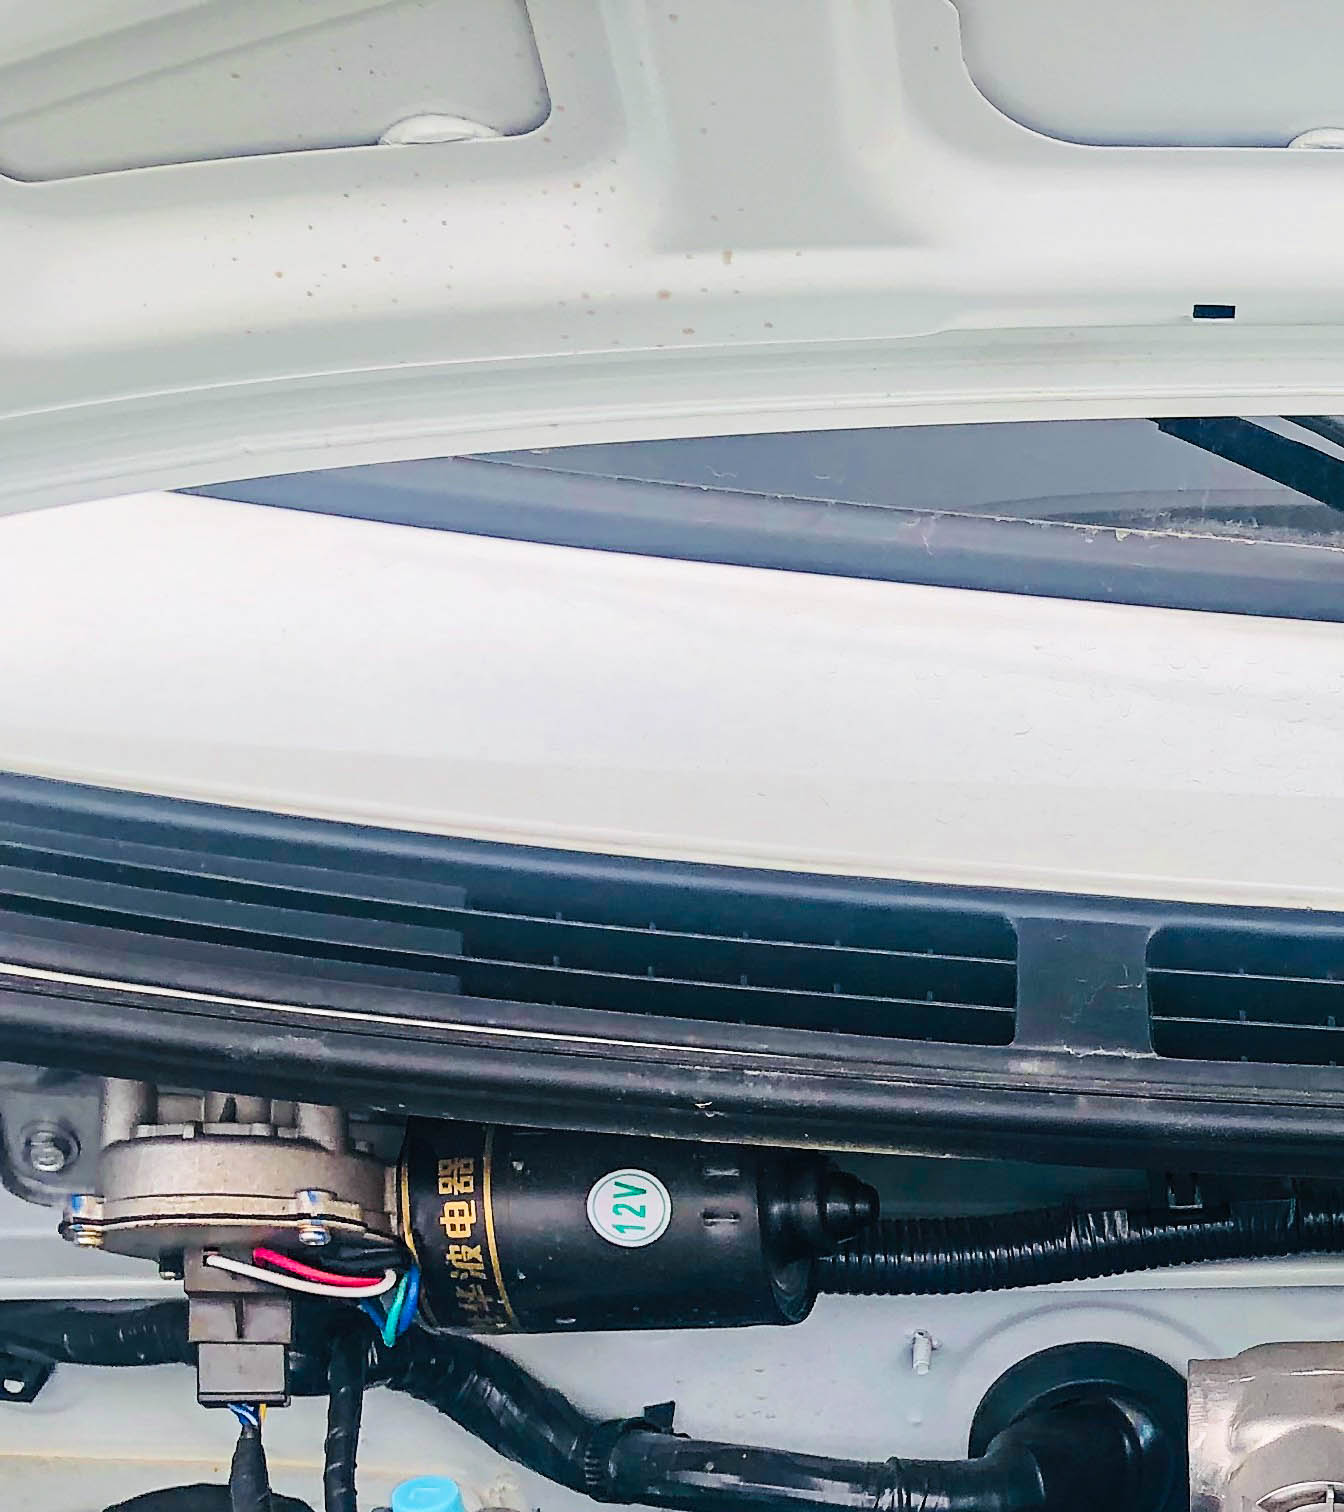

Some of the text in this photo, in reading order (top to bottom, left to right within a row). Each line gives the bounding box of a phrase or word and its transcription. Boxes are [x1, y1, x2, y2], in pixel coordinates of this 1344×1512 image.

[436, 1157, 496, 1326] 华波电器
[611, 1180, 647, 1235] 12V
